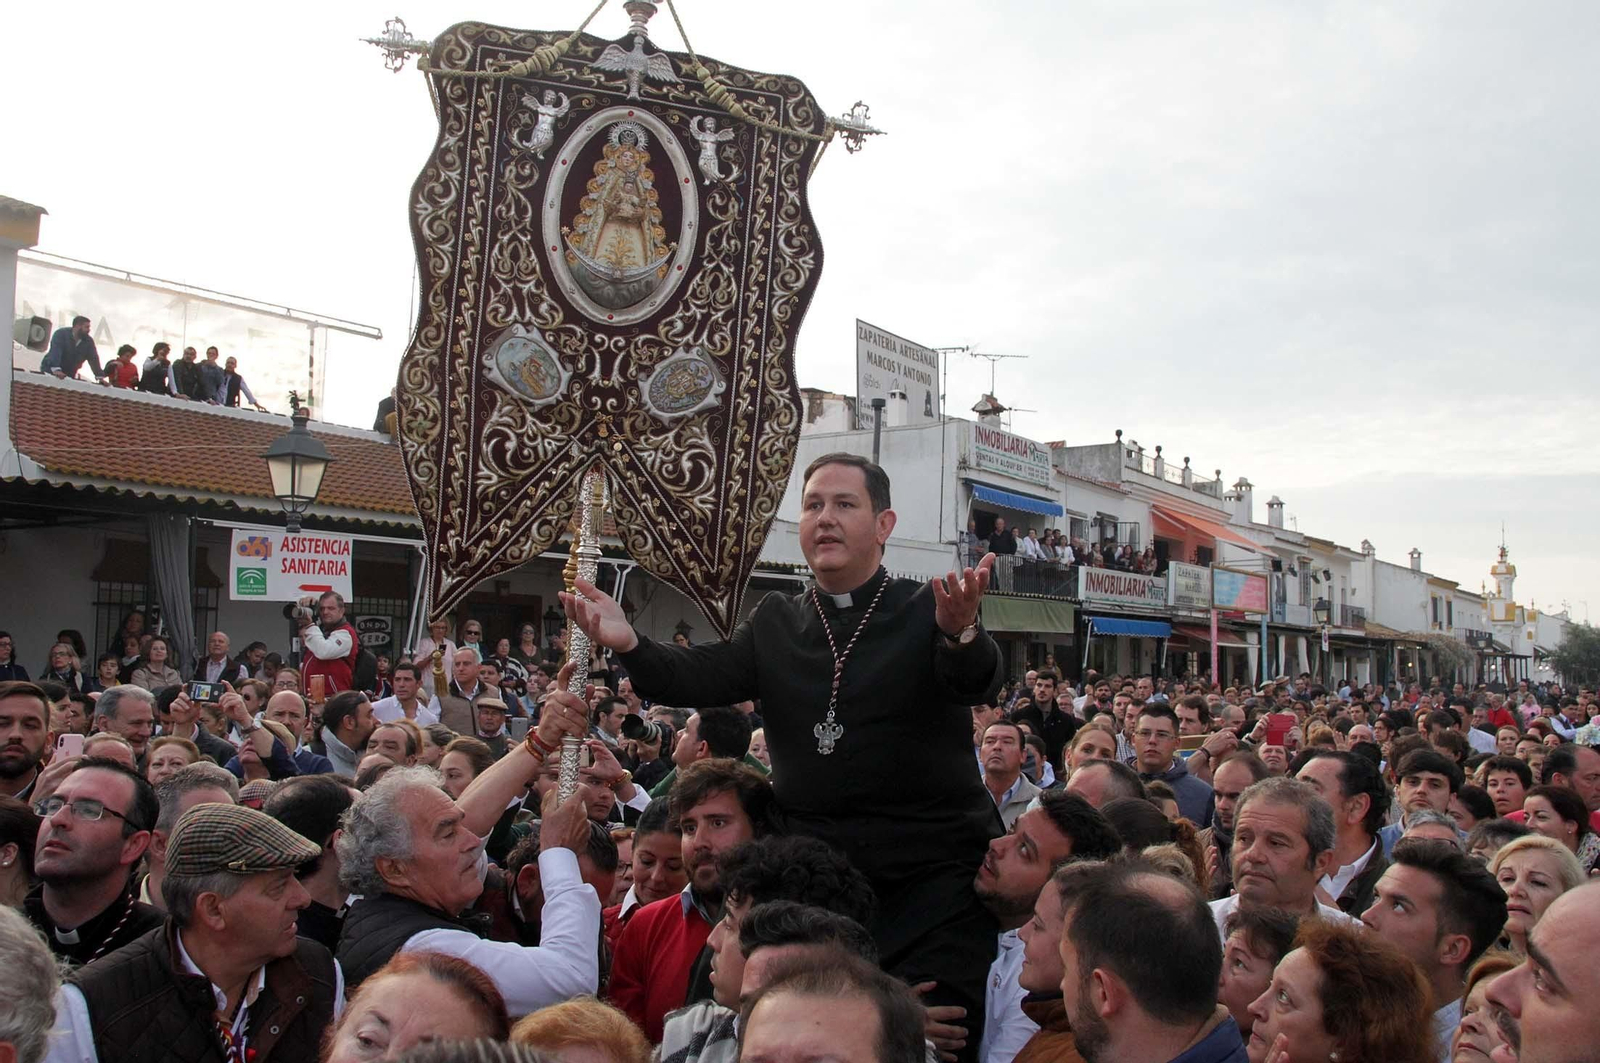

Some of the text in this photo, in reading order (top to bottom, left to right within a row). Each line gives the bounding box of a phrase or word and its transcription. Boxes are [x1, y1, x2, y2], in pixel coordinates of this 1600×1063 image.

[859, 327, 936, 369] ZAPATERÍA ARTESANAL
[867, 350, 896, 373] MARCOS
[897, 362, 901, 375] Y
[903, 365, 932, 387] ANTONIO
[975, 425, 1028, 458] INMOBILIARIA
[976, 451, 994, 464] VENTAS
[280, 536, 350, 556] ASISTENCIA
[281, 557, 347, 576] SANITARIA
[1085, 571, 1146, 598] INMOBILIARIA
[360, 621, 386, 629] ONDA
[361, 634, 386, 643] CERO
